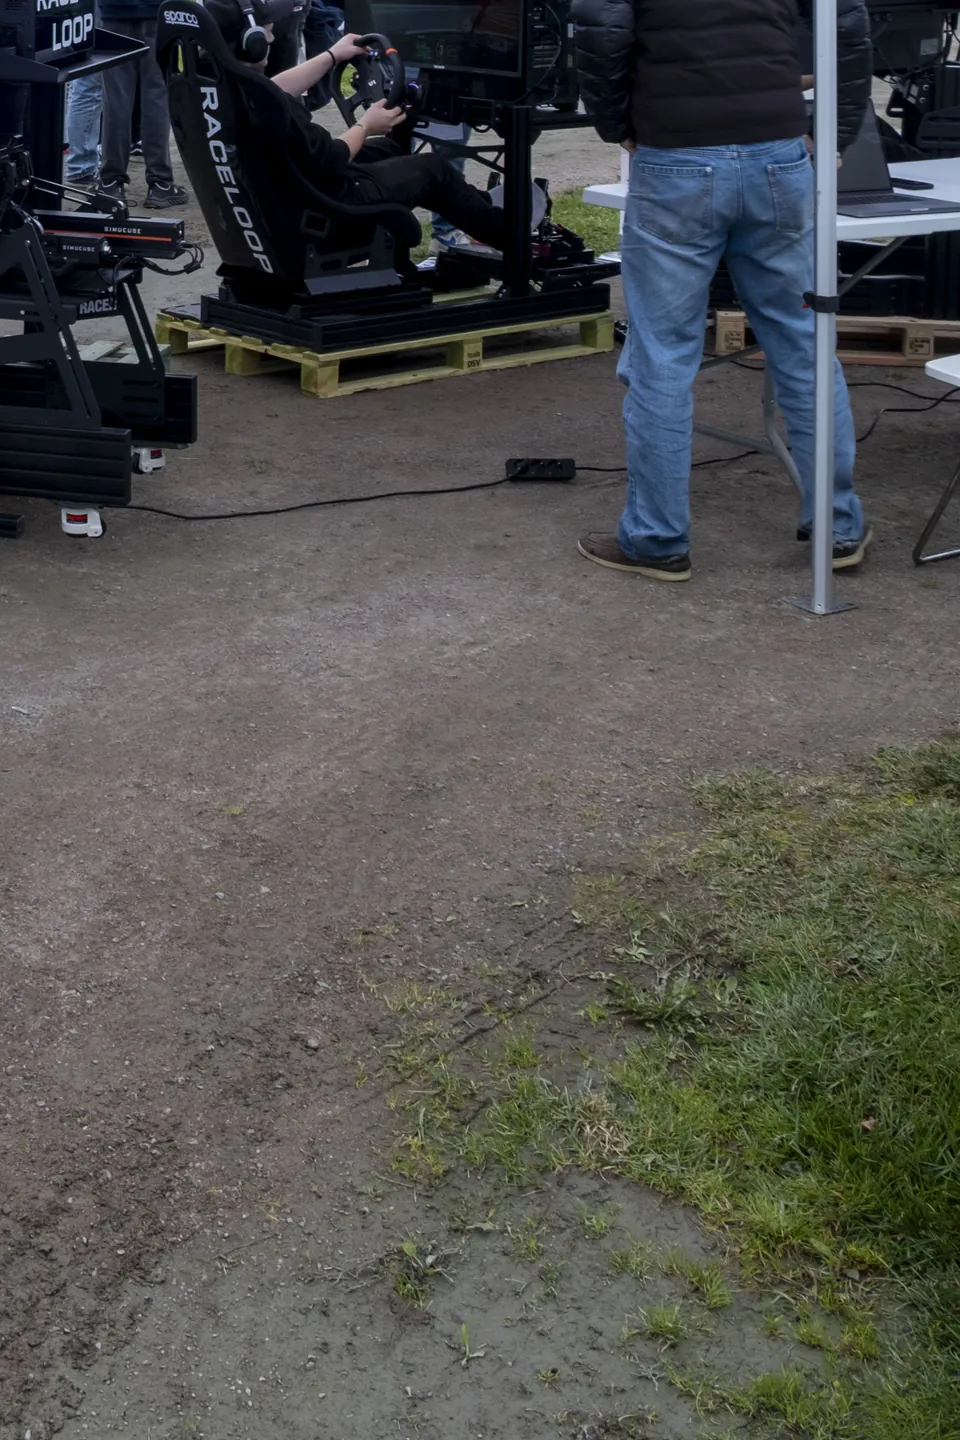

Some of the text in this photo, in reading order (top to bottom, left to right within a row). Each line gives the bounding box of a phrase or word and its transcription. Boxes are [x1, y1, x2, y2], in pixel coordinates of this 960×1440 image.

[52, 12, 93, 51] LOOP
[164, 10, 199, 26] sparco
[201, 86, 274, 274] RACELOOP
[103, 226, 142, 234] SIMUCUBE
